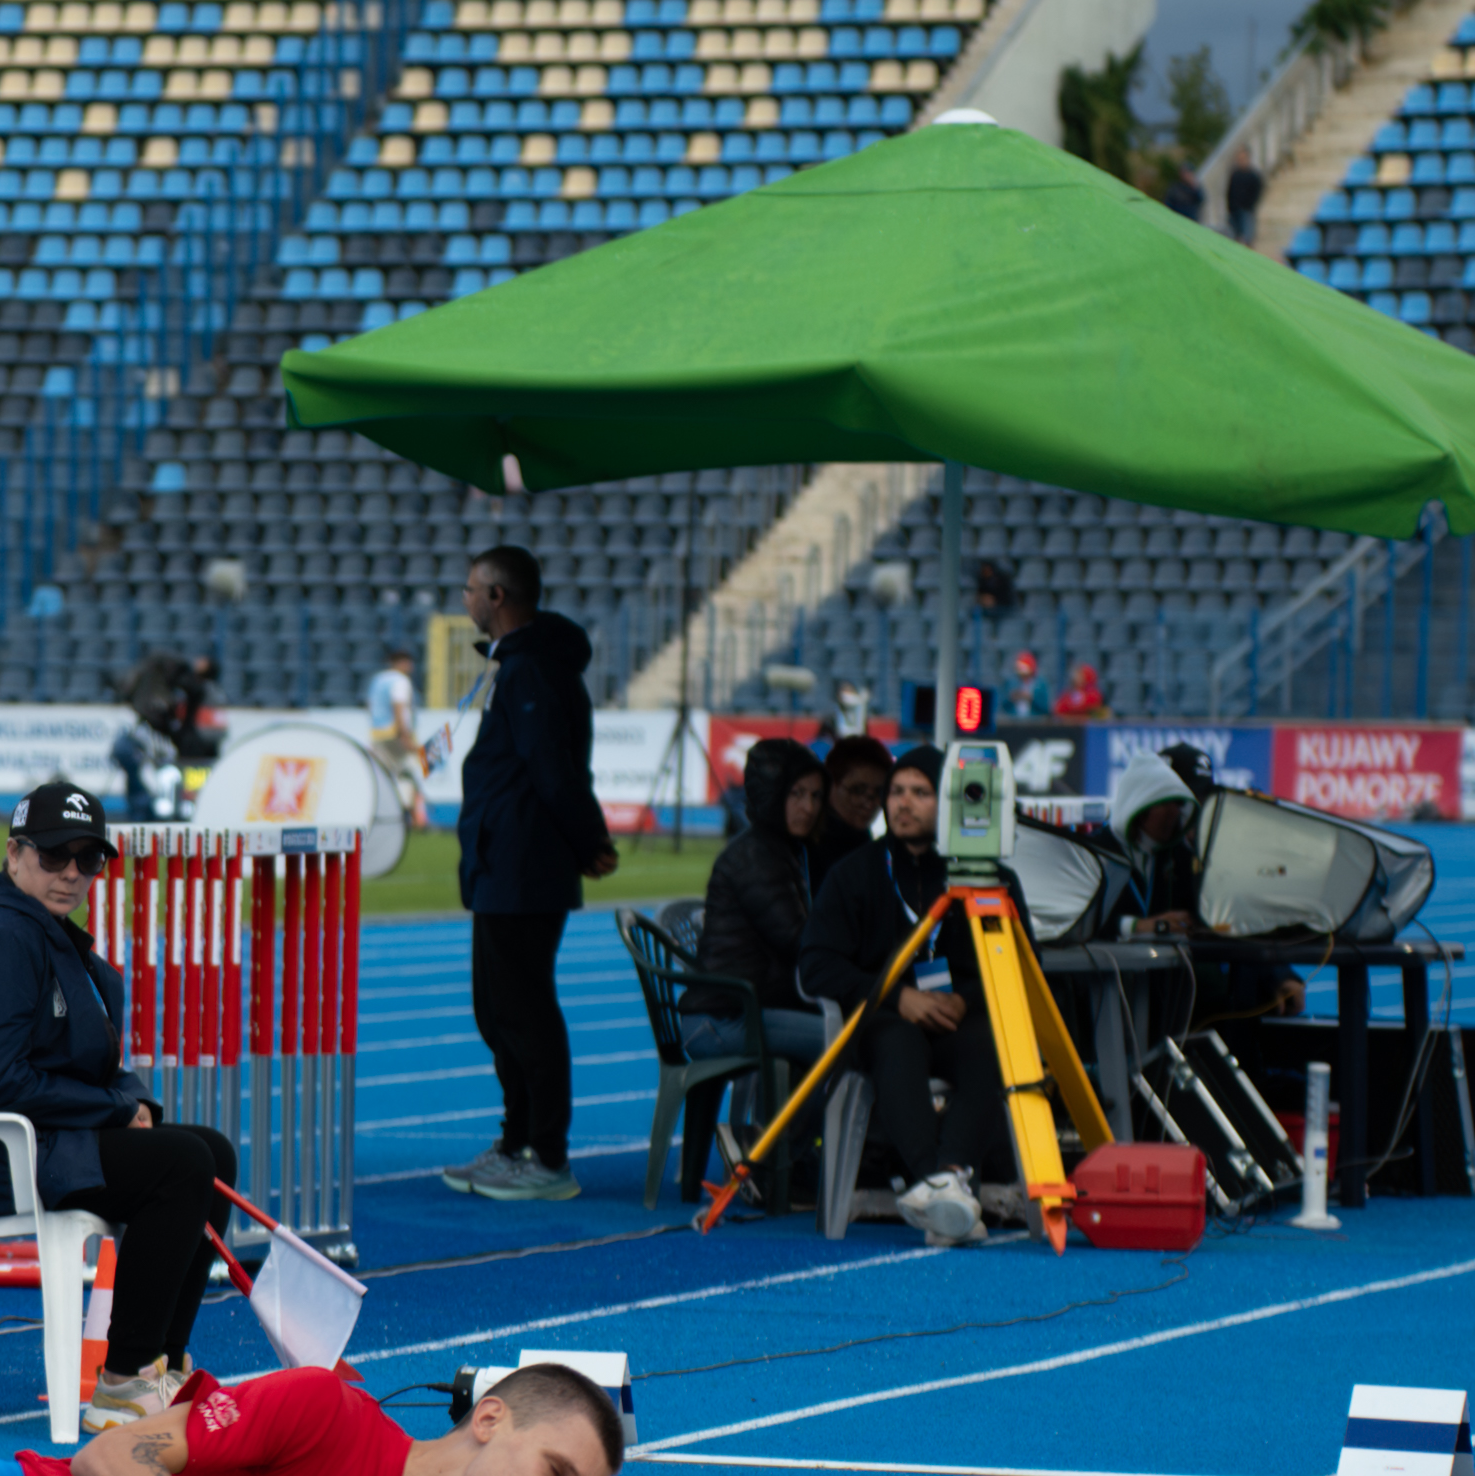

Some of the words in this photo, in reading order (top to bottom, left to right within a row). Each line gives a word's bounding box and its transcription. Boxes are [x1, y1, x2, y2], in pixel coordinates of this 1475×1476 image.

[955, 686, 982, 732] 0
[1013, 738, 1075, 792] 4F
[1295, 730, 1422, 769] KUJAWY
[1295, 771, 1444, 811] POMORZE
[62, 810, 93, 823] ORLEN
